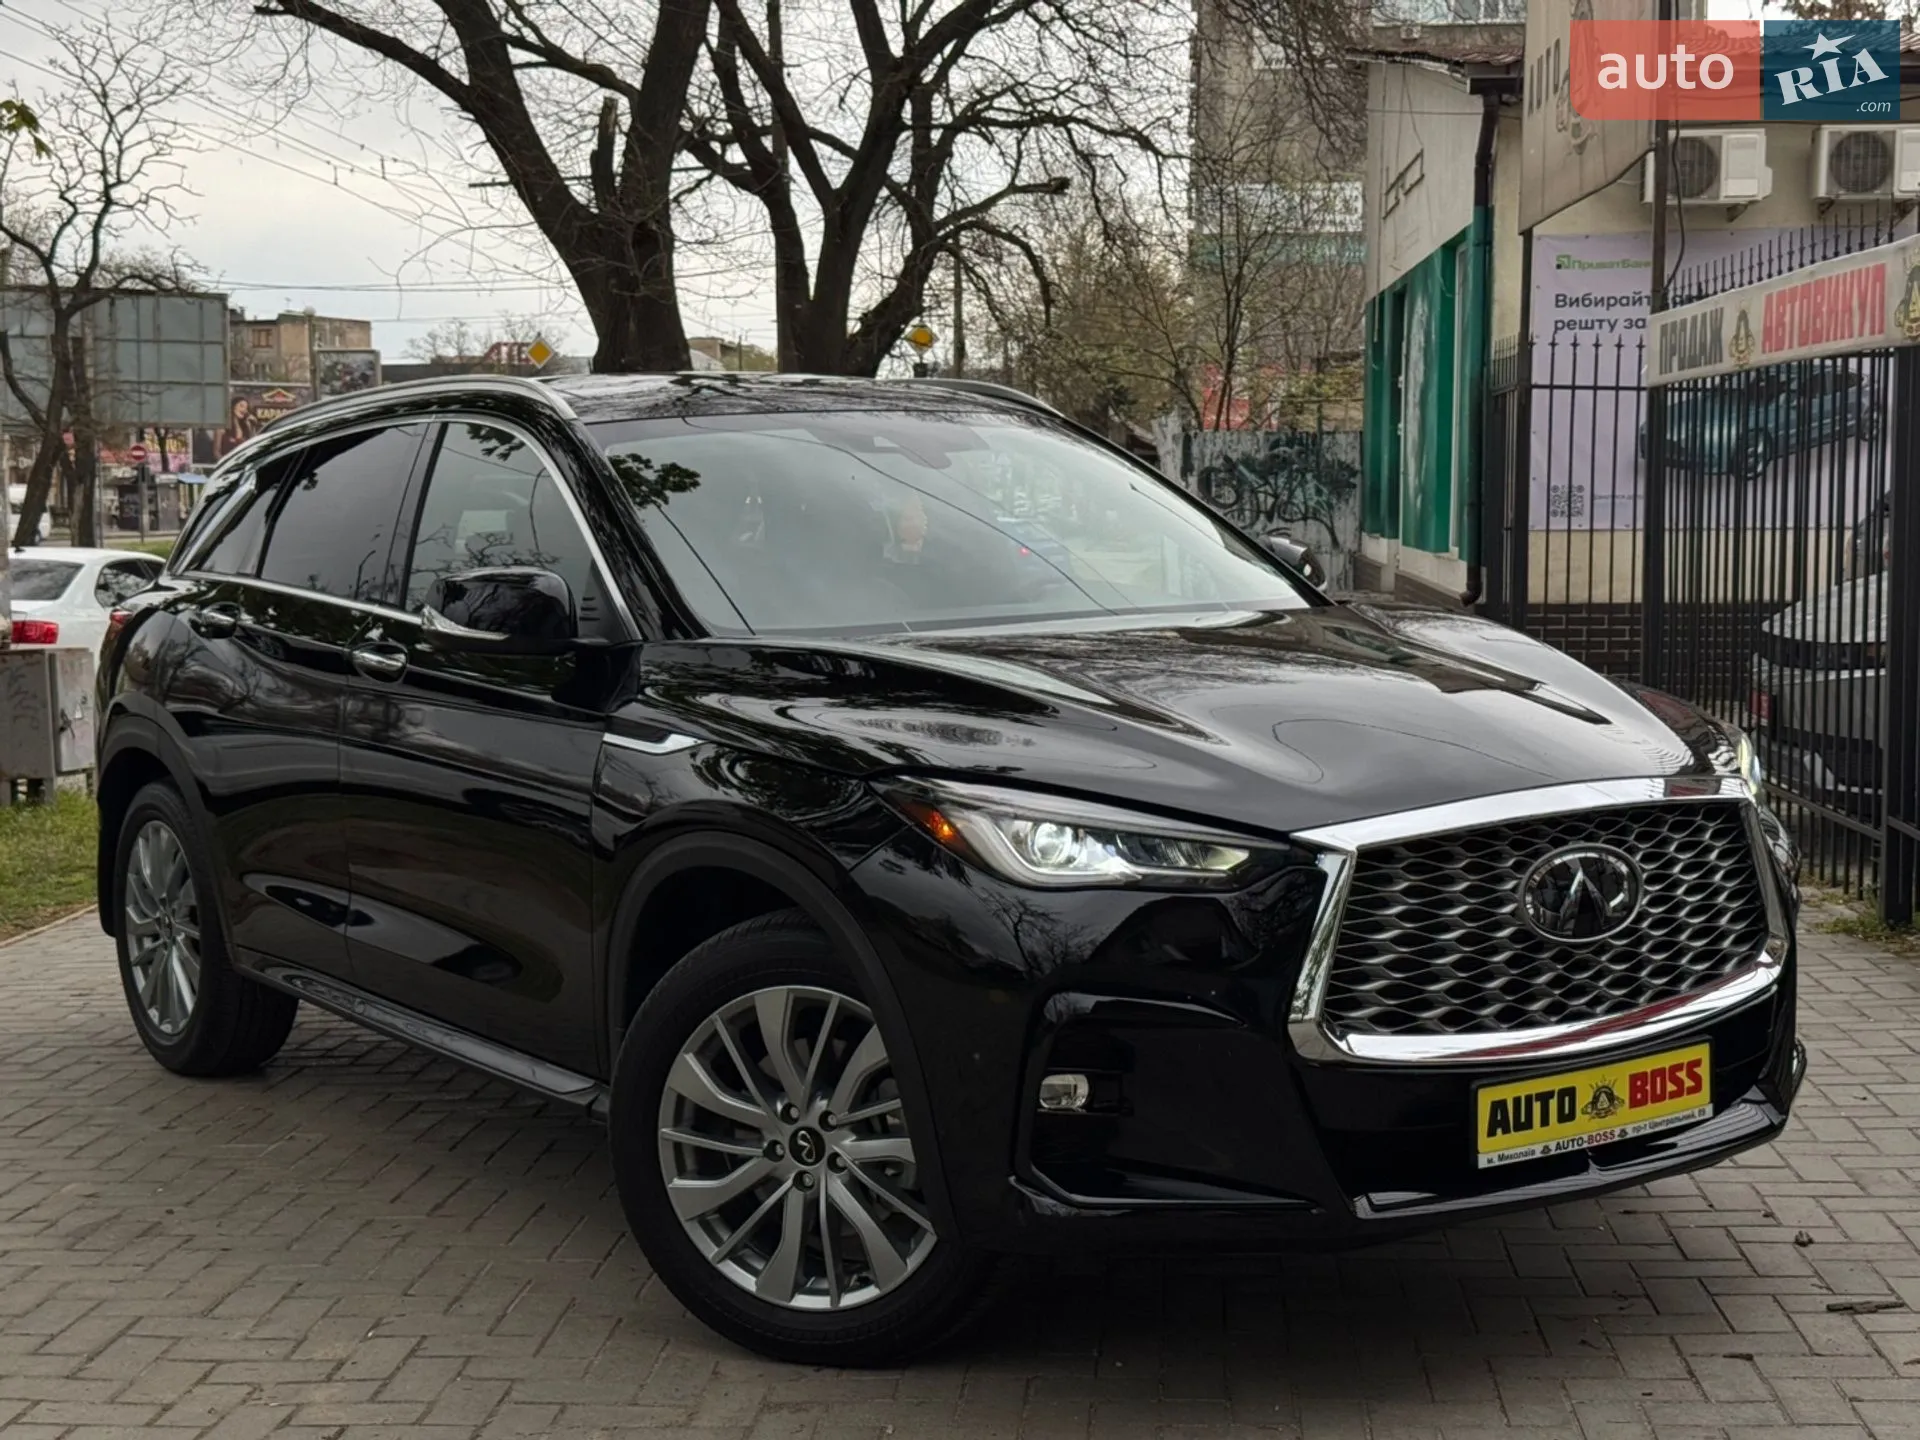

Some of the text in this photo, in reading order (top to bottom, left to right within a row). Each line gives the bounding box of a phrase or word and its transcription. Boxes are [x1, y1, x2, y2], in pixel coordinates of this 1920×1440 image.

[1554, 290, 1652, 311] Вибирайт
[1554, 318, 1619, 334] решту
[1659, 262, 1886, 376] ПРОДАЖ АВТОВИКУП
[1487, 1057, 1703, 1138] AUTO BOSS
[1497, 1147, 1536, 1162] Миколаїв
[1554, 1129, 1616, 1151] AUTO-BOSS
